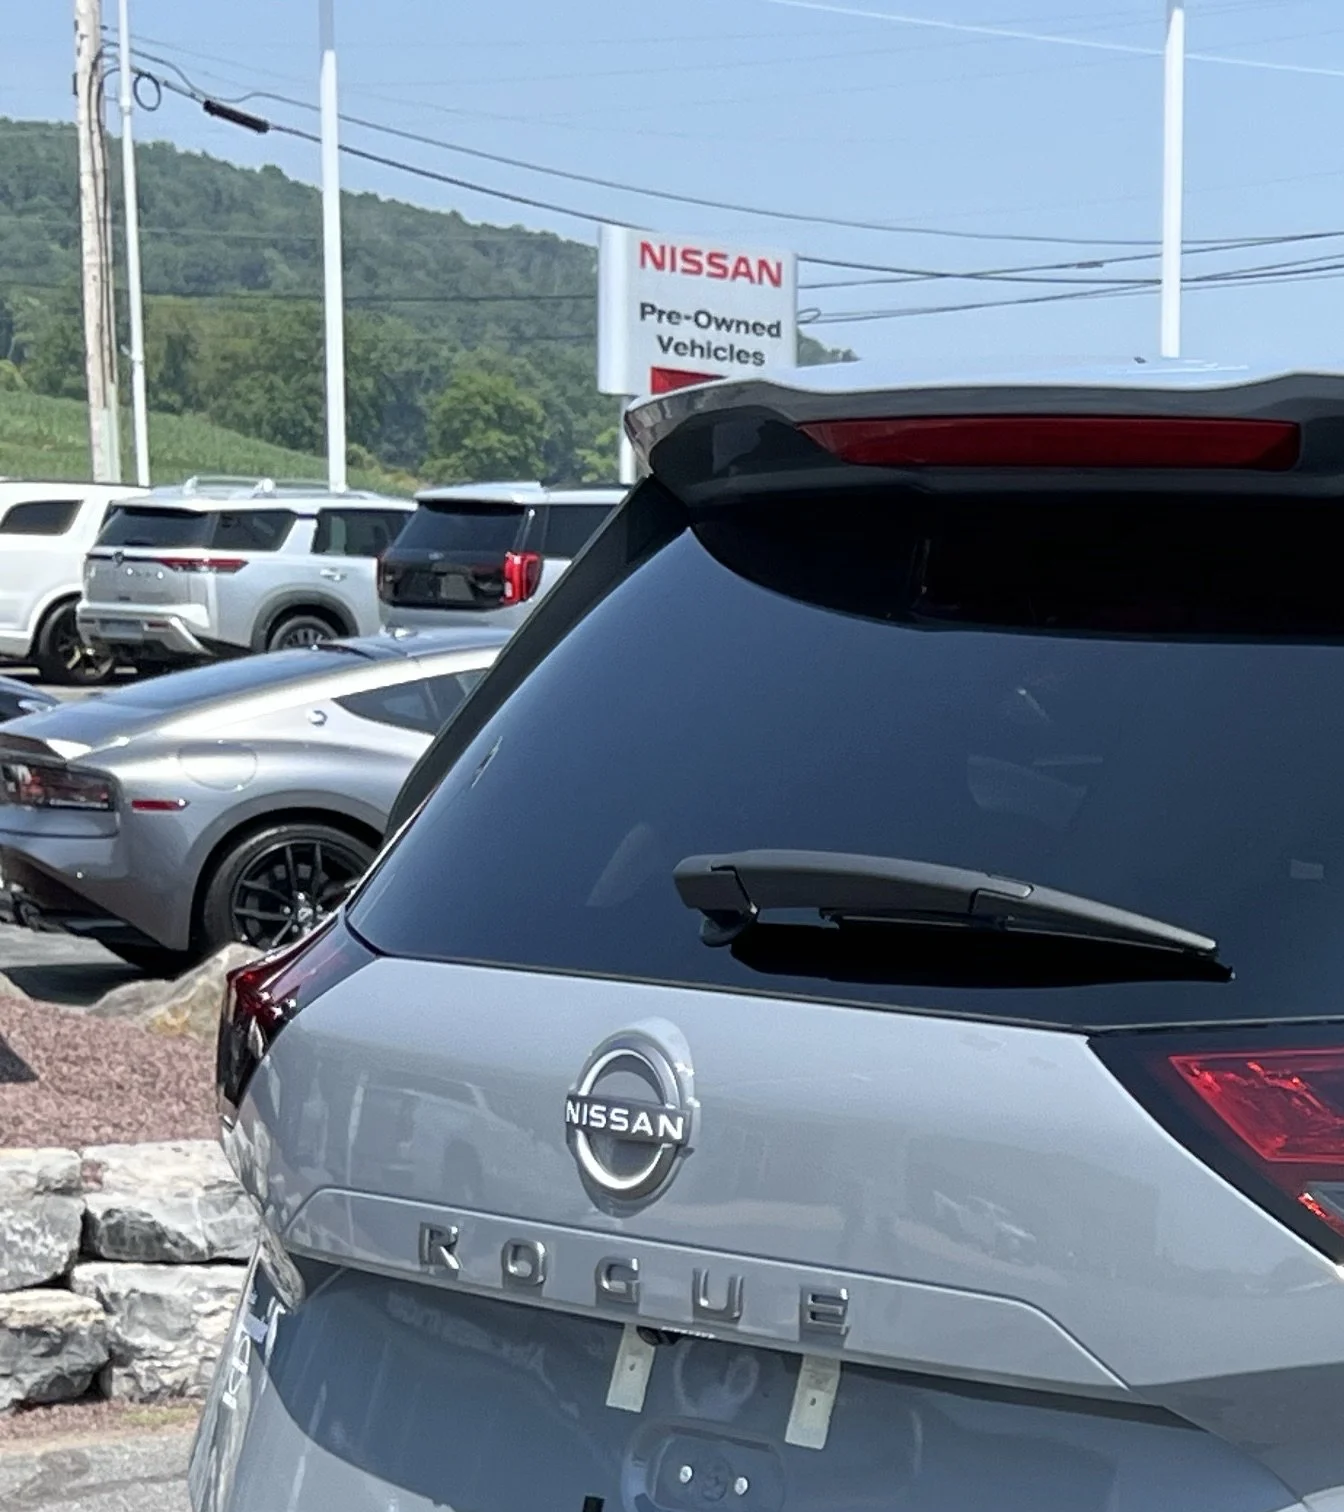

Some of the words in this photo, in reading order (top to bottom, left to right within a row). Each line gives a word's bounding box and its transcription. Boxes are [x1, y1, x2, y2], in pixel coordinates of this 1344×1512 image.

[640, 240, 782, 288] NISSAN
[639, 302, 782, 338] Pre-Owned
[657, 335, 766, 366] Vehicles
[565, 1100, 684, 1140] NISSAN
[418, 1221, 850, 1337] ROGUE
